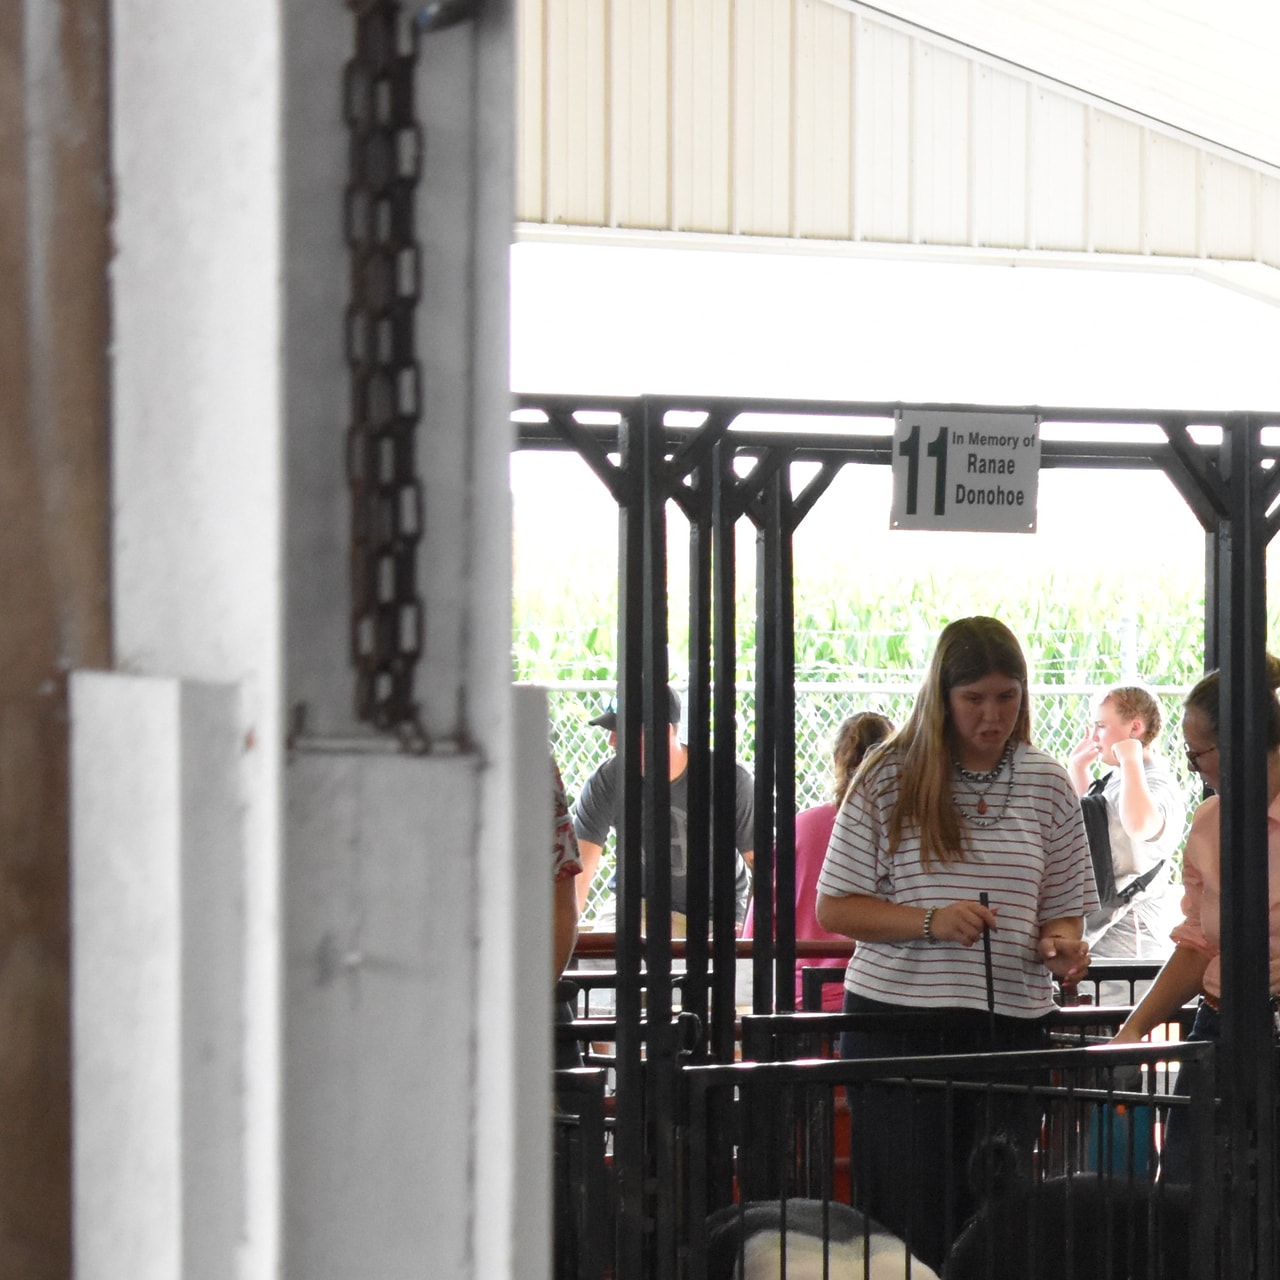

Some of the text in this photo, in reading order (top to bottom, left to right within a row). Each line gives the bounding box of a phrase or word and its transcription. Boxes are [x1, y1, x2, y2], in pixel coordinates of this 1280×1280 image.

[952, 431, 1036, 450] In Memory of
[899, 425, 949, 516] 11
[967, 453, 1015, 475] Ranae
[955, 483, 1025, 506] Donohoe
